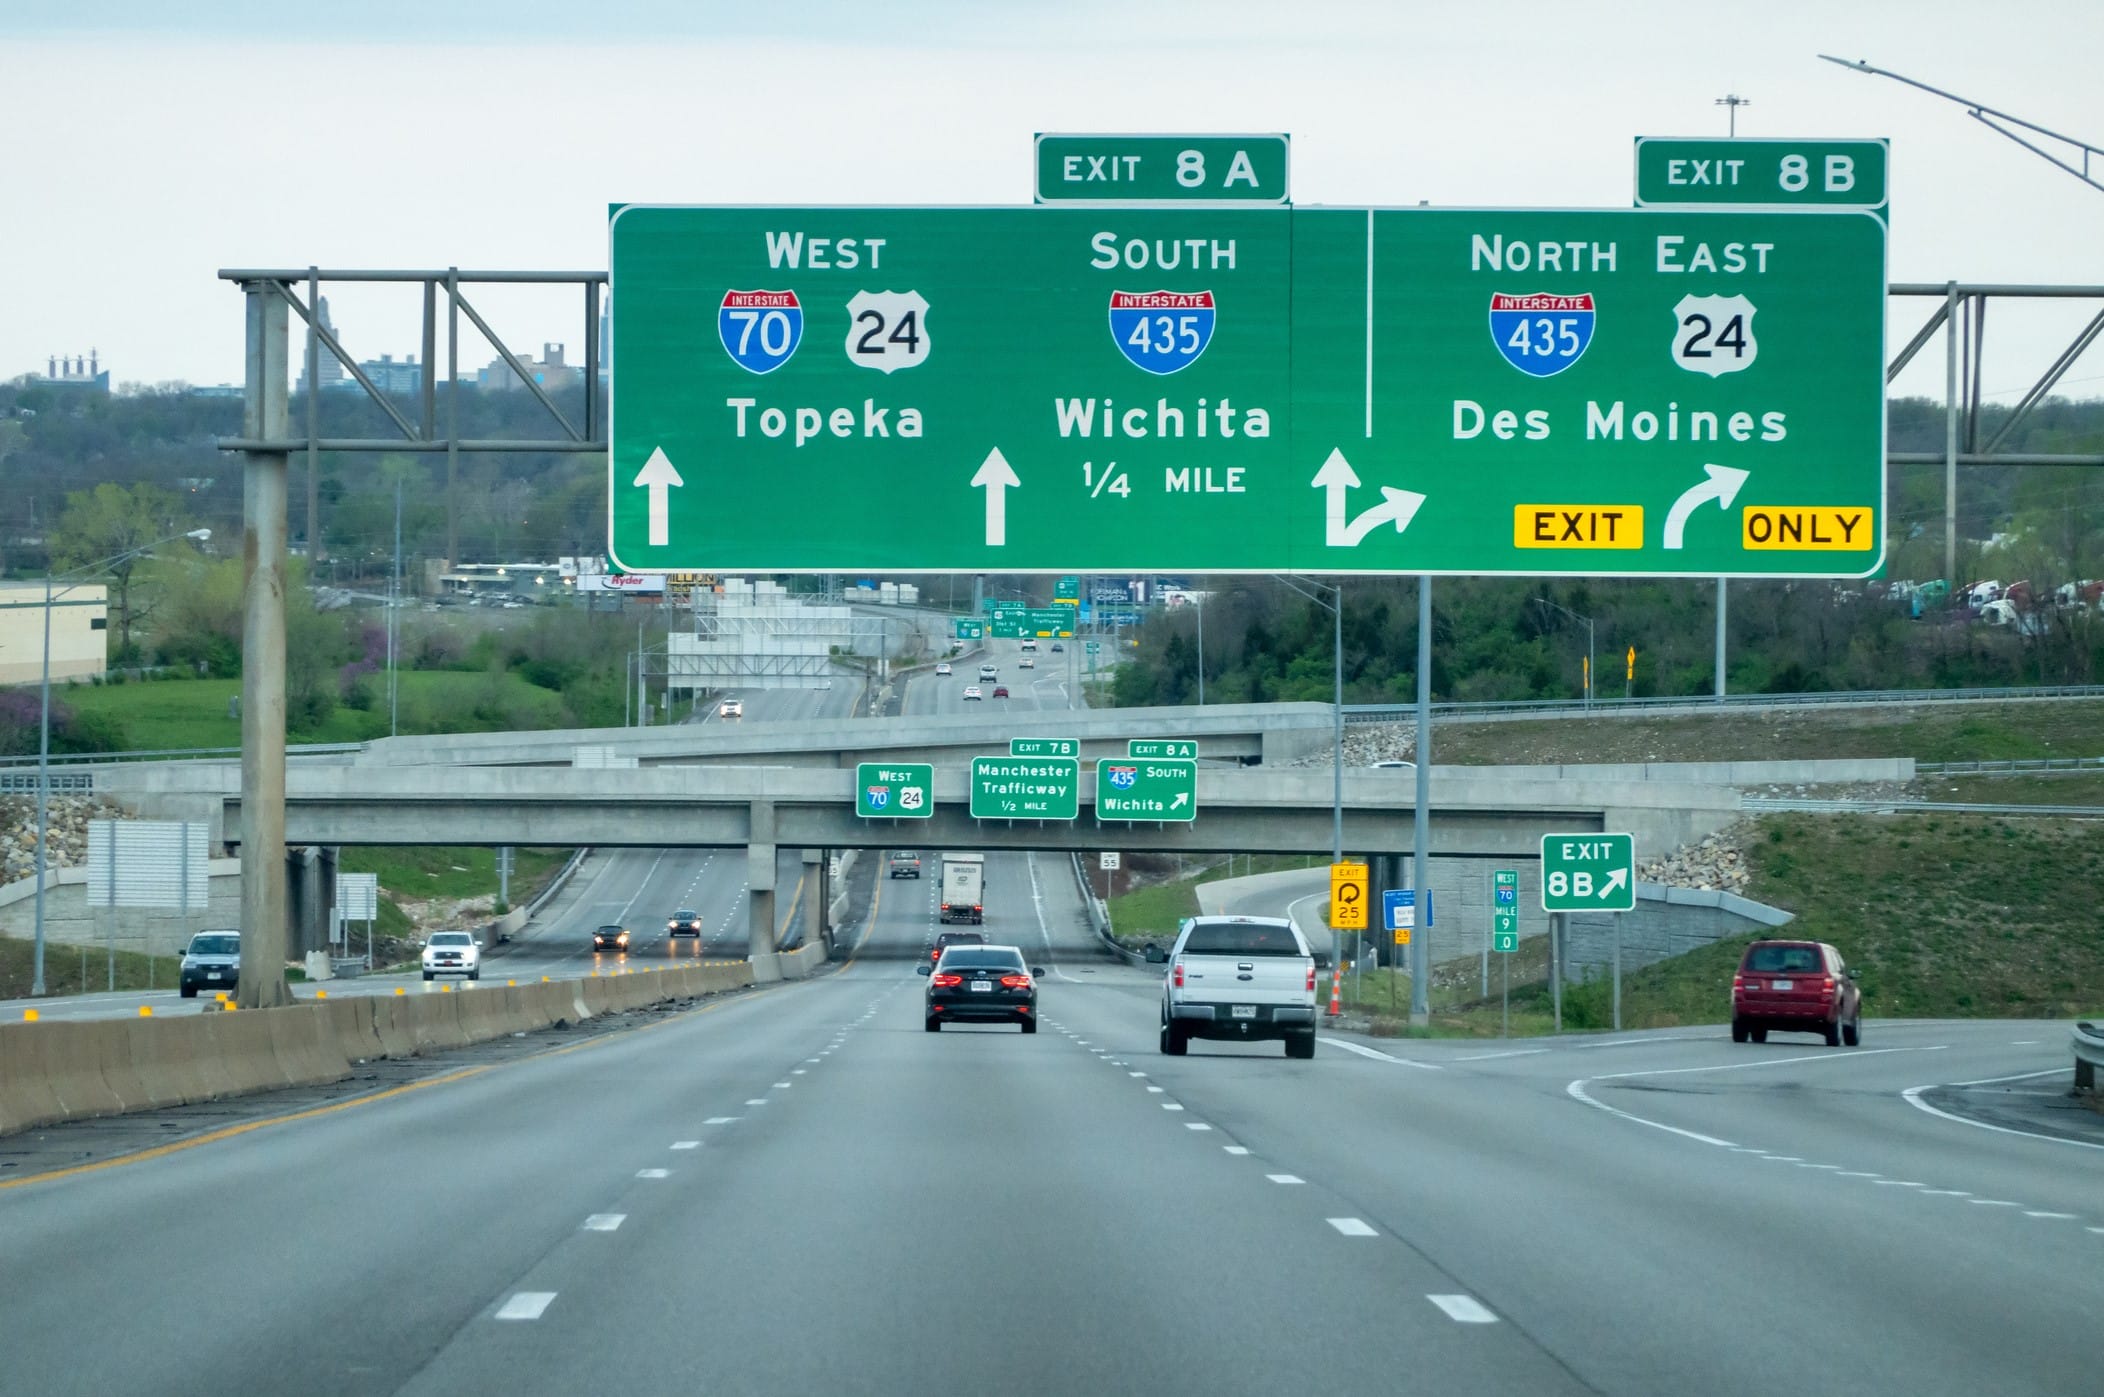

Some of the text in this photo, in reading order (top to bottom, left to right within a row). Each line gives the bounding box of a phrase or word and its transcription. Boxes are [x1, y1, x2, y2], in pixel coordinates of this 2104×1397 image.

[1063, 156, 1141, 181] EXIT
[1668, 160, 1744, 186] EXIT
[765, 231, 886, 269] WEST
[1089, 231, 1236, 270] SOUTH
[1472, 234, 1774, 273] NORTH EAST
[731, 295, 790, 306] INTERSTATE
[1119, 295, 1205, 307] INTERSTATE
[1500, 298, 1585, 309] INTERSTATE
[729, 311, 791, 357] 70
[856, 310, 919, 354] 24
[1128, 316, 1200, 354] 435
[1508, 318, 1579, 357] 435
[1682, 314, 1747, 358] 24
[726, 398, 923, 448] Topeka
[1055, 397, 1271, 438] Wichita
[1453, 400, 1787, 441] Des Moines
[1082, 461, 1246, 498] 1/4 MILE
[1534, 512, 1622, 541] EXIT
[1748, 513, 1861, 543] ONLY
[611, 575, 644, 586] Ryder
[1019, 744, 1041, 752] EXIT
[879, 770, 912, 781] WEST
[978, 764, 1072, 776] Manchester
[1146, 766, 1187, 778] SOUTH
[1111, 772, 1135, 785] 435
[982, 782, 1067, 797] Trafficway
[869, 792, 887, 805] 70
[903, 792, 920, 805] 24
[1104, 798, 1163, 811] Wichita
[1001, 801, 1047, 811] 1/2 MILE
[1562, 842, 1613, 860] EXIT
[1103, 859, 1117, 867] 55
[1497, 874, 1515, 883] WEST
[1548, 871, 1594, 897] 8B
[1500, 890, 1513, 900] 70
[1339, 907, 1359, 919] 25
[1495, 906, 1516, 916] MILE
[1502, 918, 1510, 929] 9
